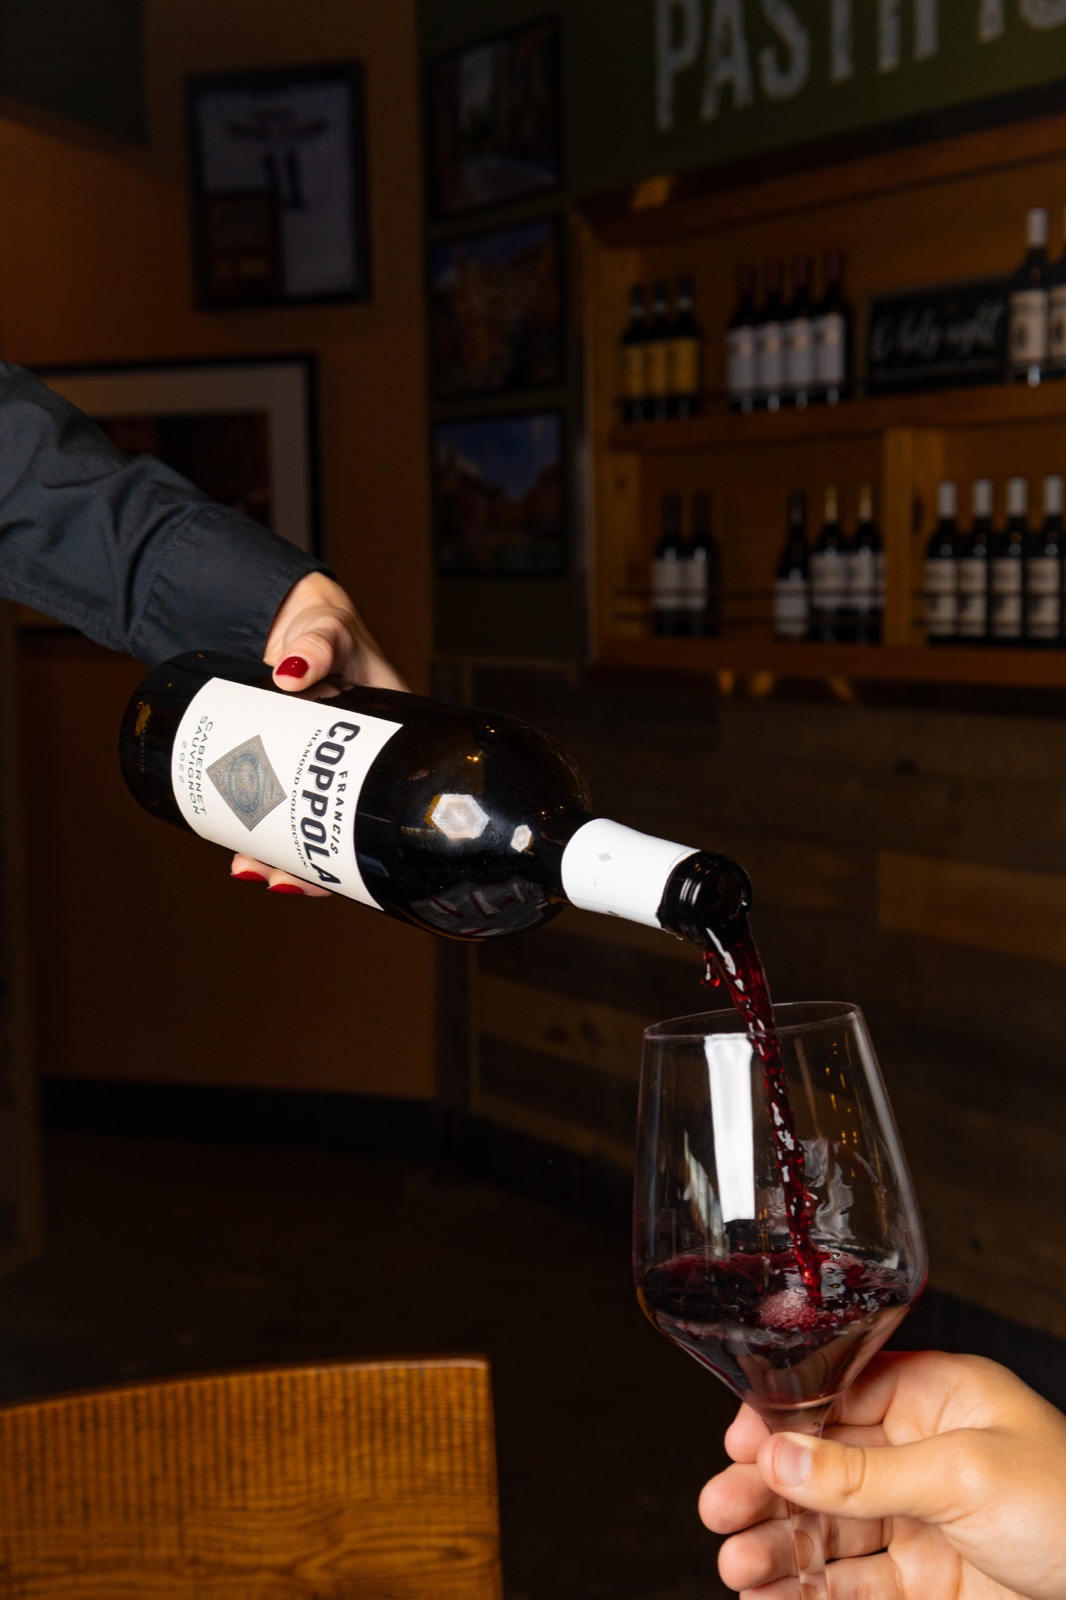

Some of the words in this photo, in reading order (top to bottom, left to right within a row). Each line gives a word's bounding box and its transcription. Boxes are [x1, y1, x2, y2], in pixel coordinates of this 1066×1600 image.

[179, 741, 188, 784] 2022
[187, 715, 208, 815] SAUVIGNON
[195, 721, 214, 815] CABERNET
[293, 728, 323, 786] DIAMOND
[290, 789, 309, 869] COLLECTION
[300, 721, 361, 885] COPPOLA
[329, 770, 349, 855] FRANCIS
